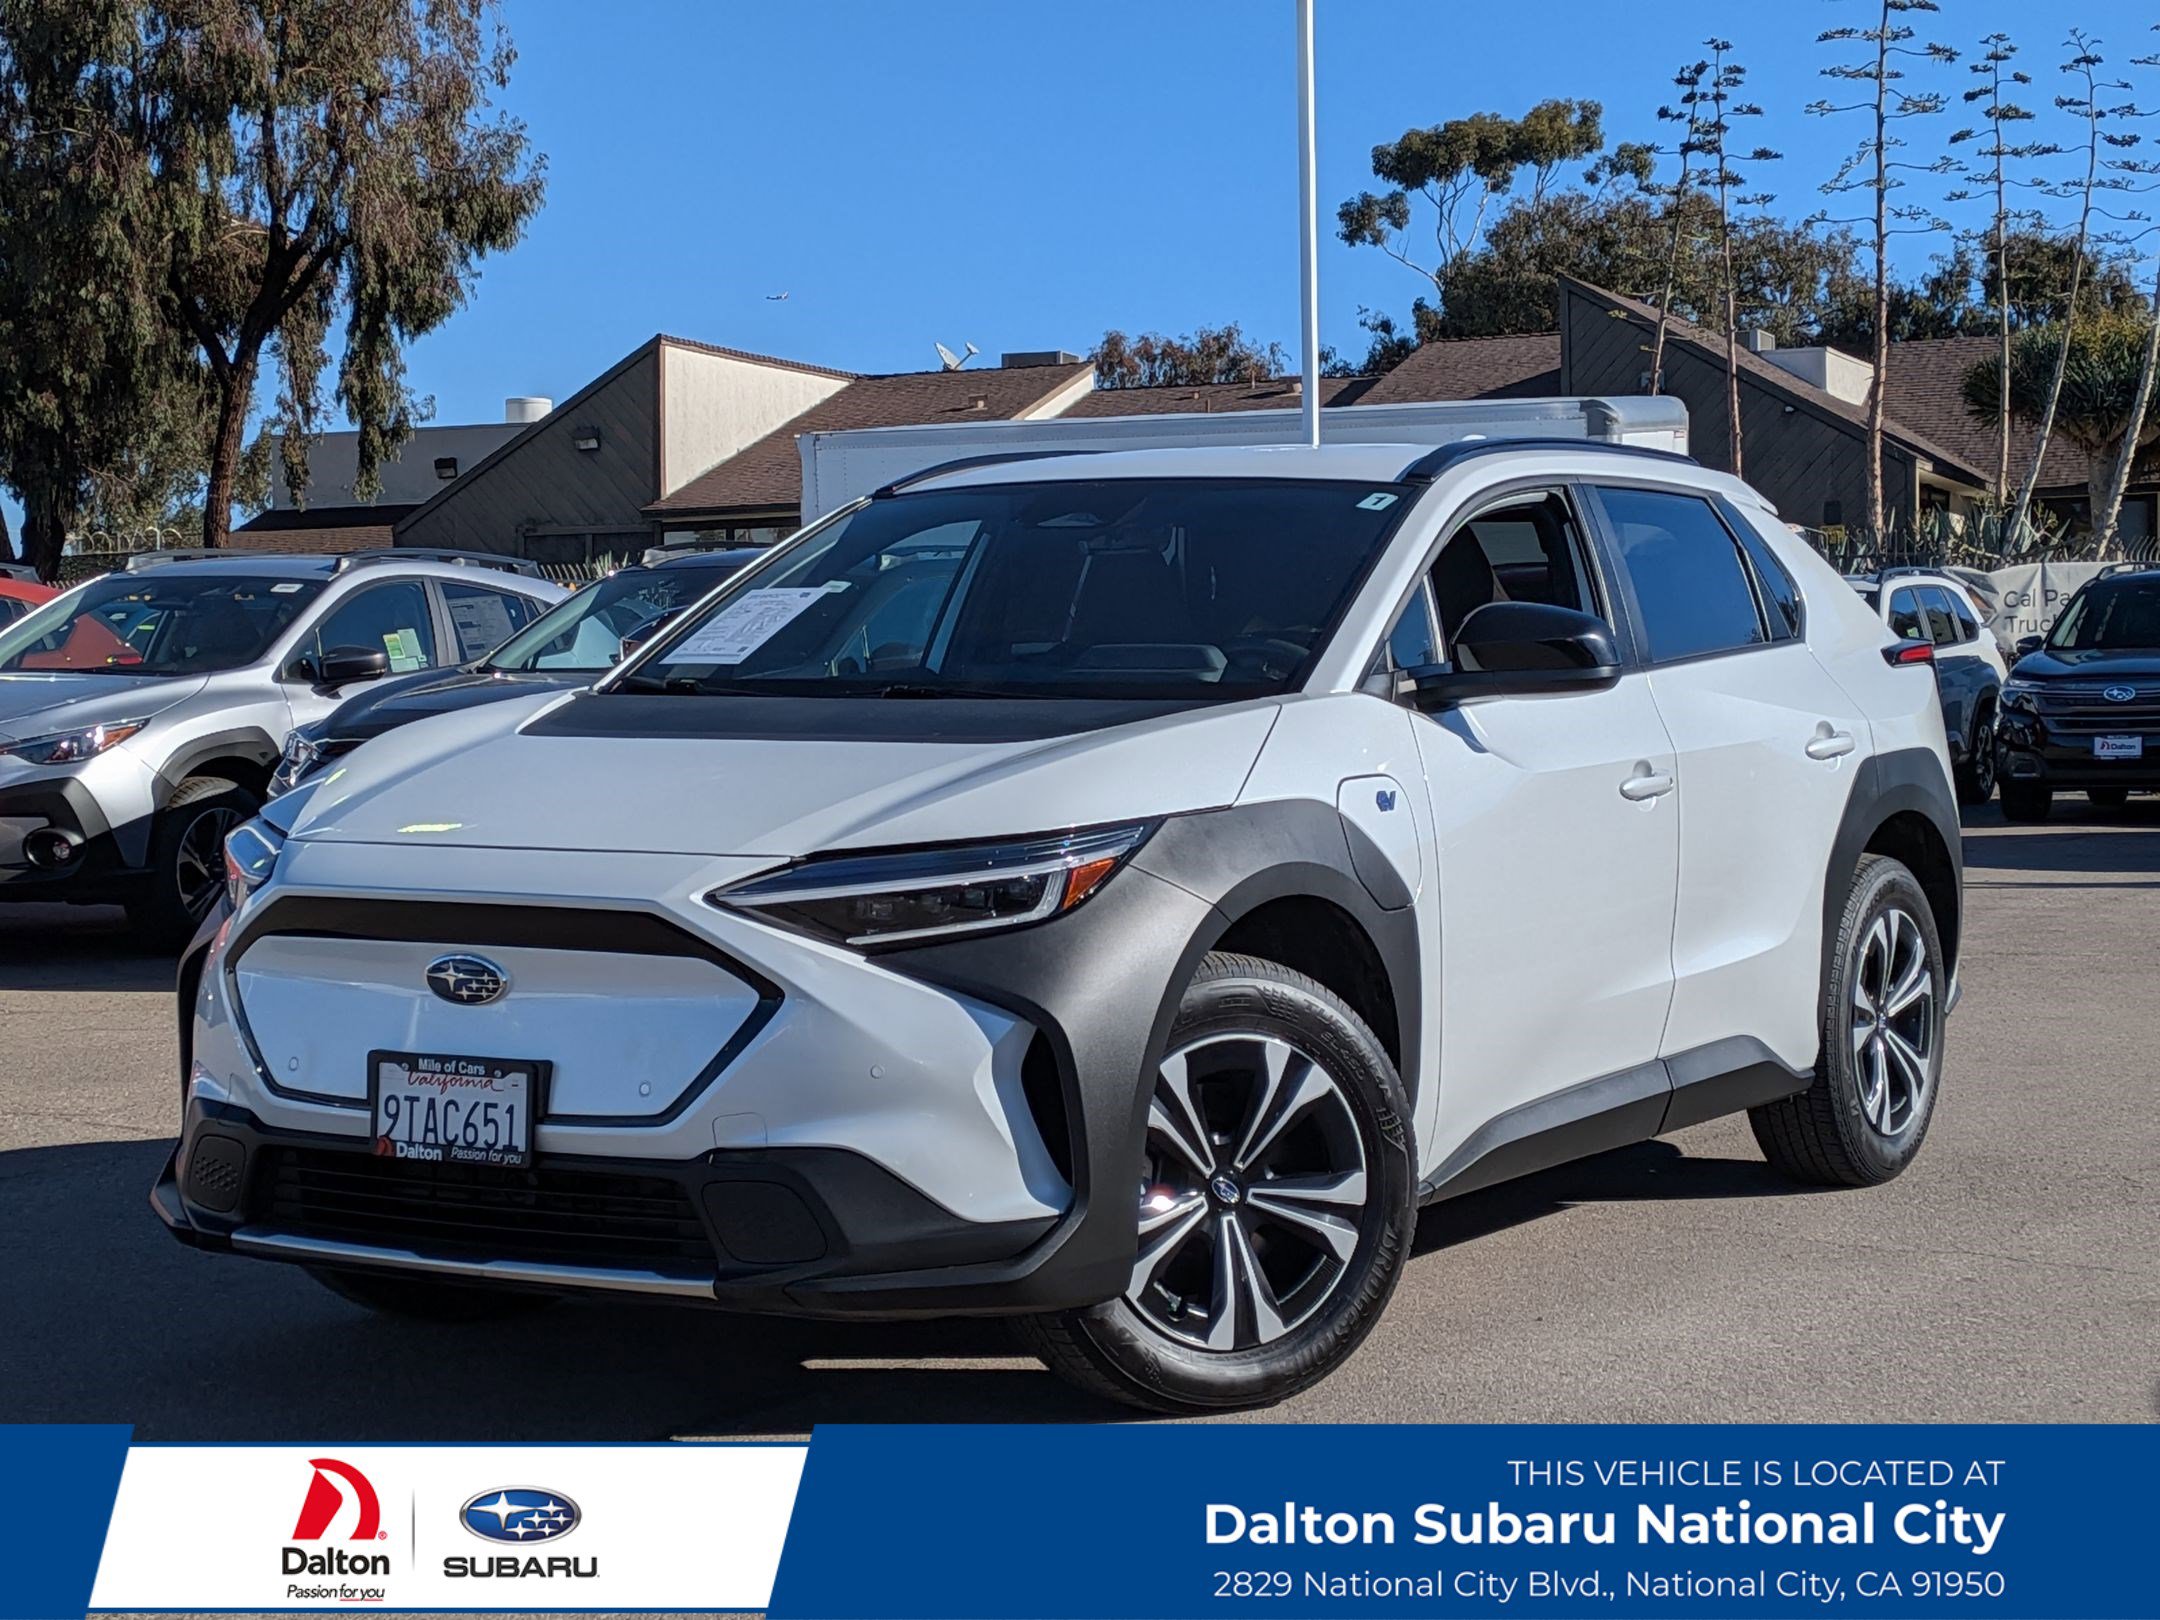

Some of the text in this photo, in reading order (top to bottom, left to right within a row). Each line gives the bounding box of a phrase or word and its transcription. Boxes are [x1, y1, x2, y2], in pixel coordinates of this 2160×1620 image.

[2004, 588, 2036, 608] Cal
[2004, 614, 2056, 633] Truc
[418, 1058, 486, 1076] Mile of Cars
[407, 1070, 504, 1095] California
[384, 1094, 519, 1151] 9TAC651
[395, 1142, 522, 1165] Dalton Passion for you
